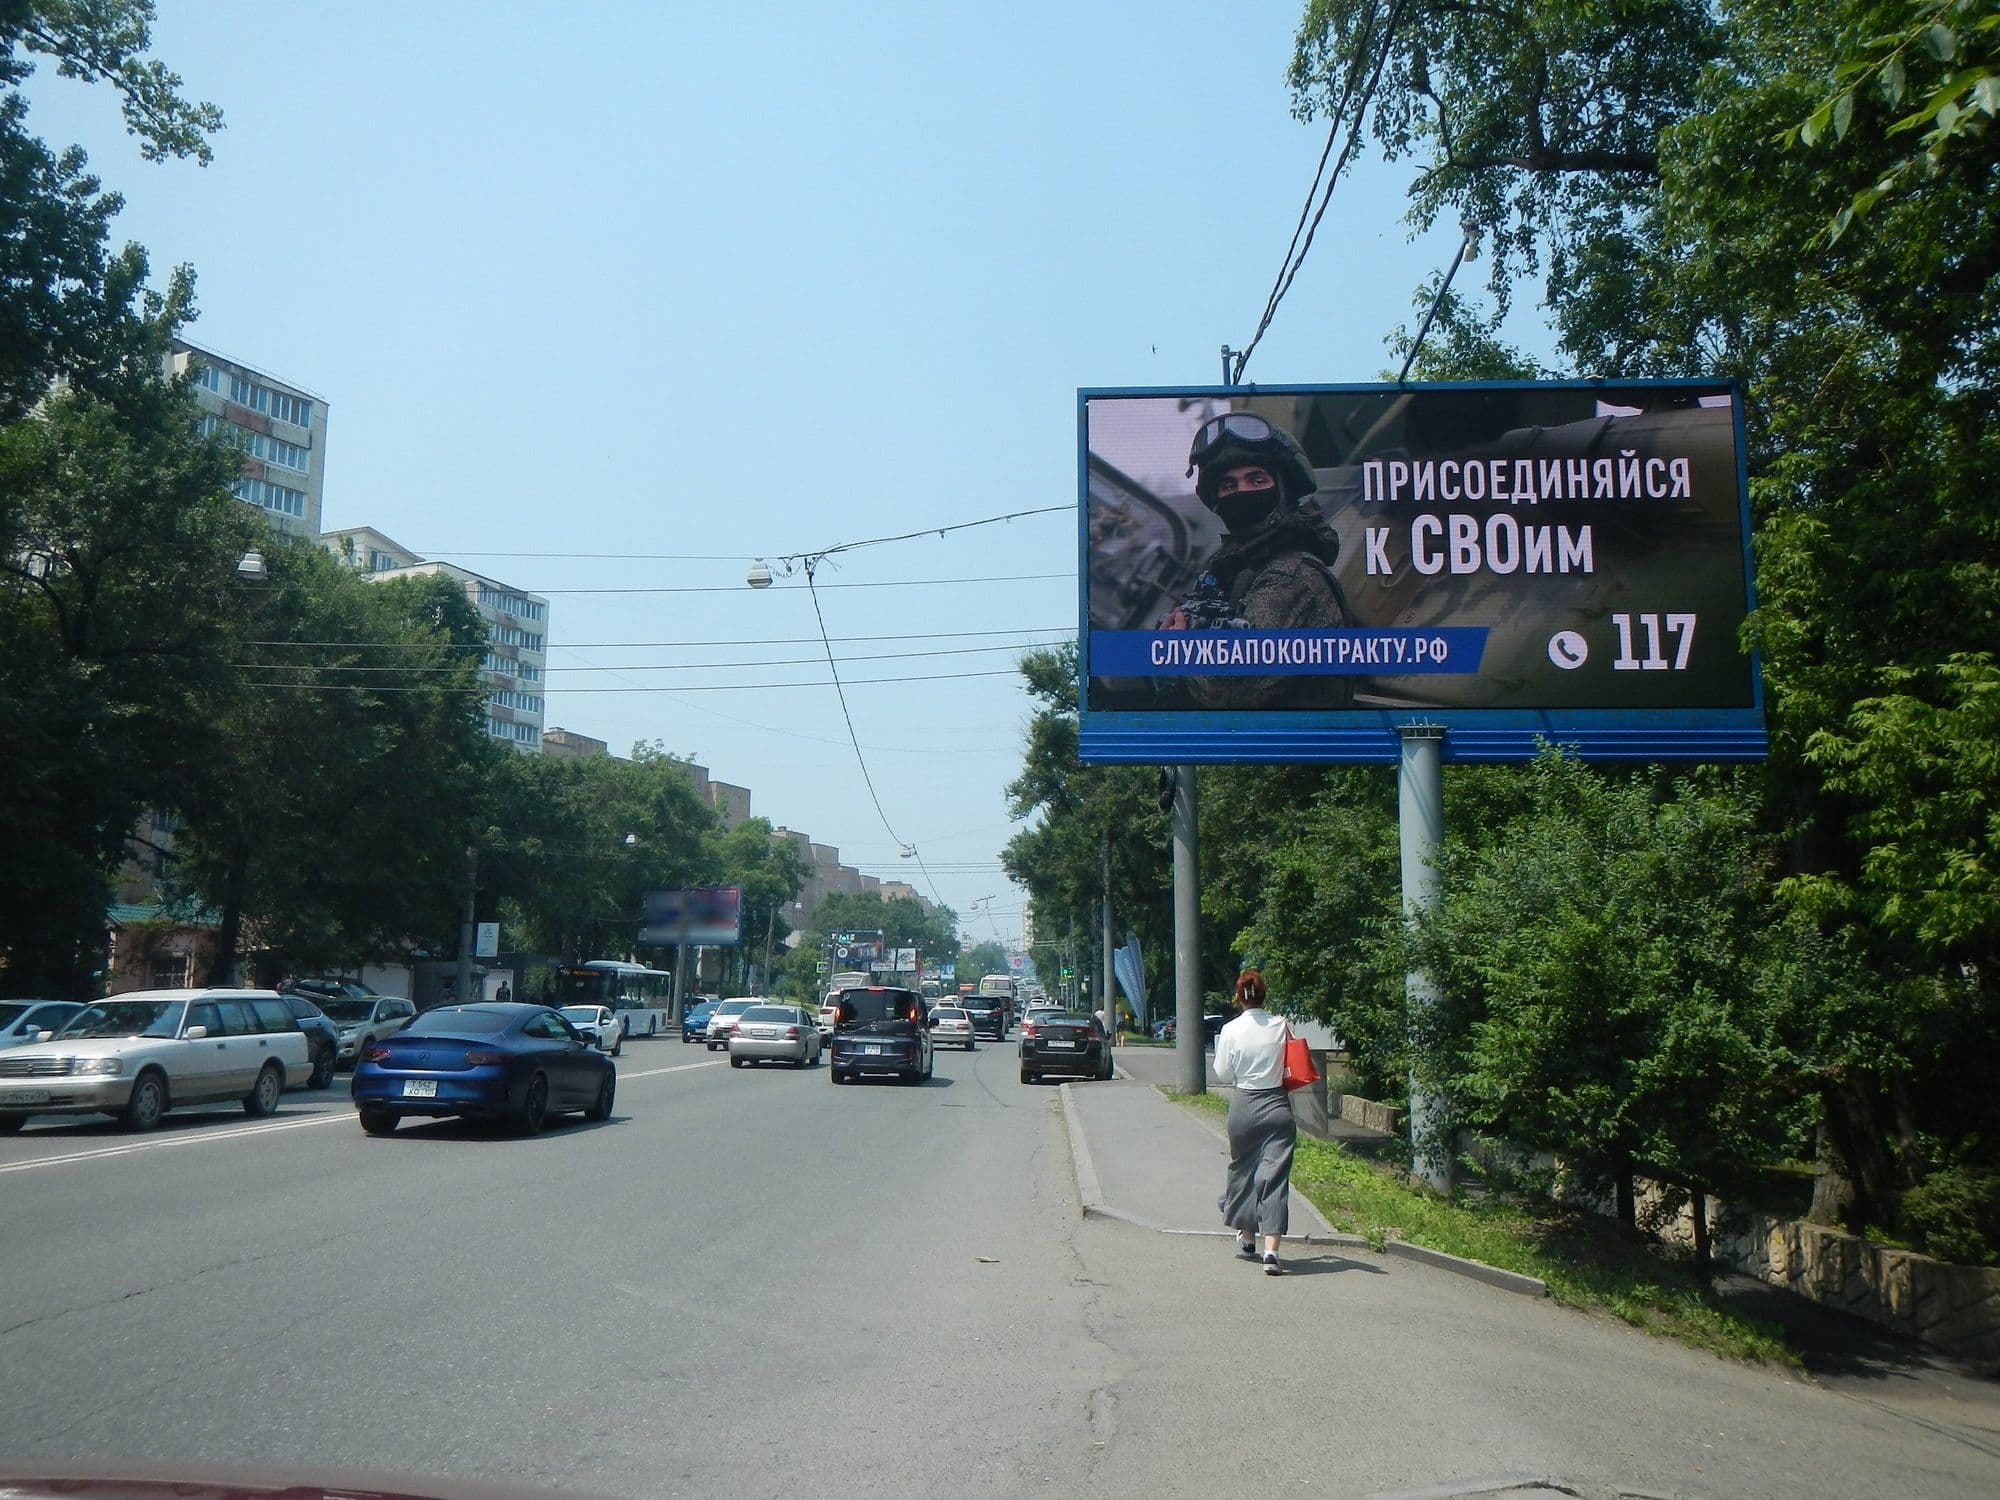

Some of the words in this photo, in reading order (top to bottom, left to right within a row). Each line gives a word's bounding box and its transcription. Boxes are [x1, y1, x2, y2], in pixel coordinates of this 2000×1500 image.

[1363, 449, 1691, 504] ПРИСОЕДИНЯЙСЯ
[1151, 636, 1449, 666] СЛУЖБАПОКОНТРАКТУ.РФ
[1612, 613, 1697, 670] 117
